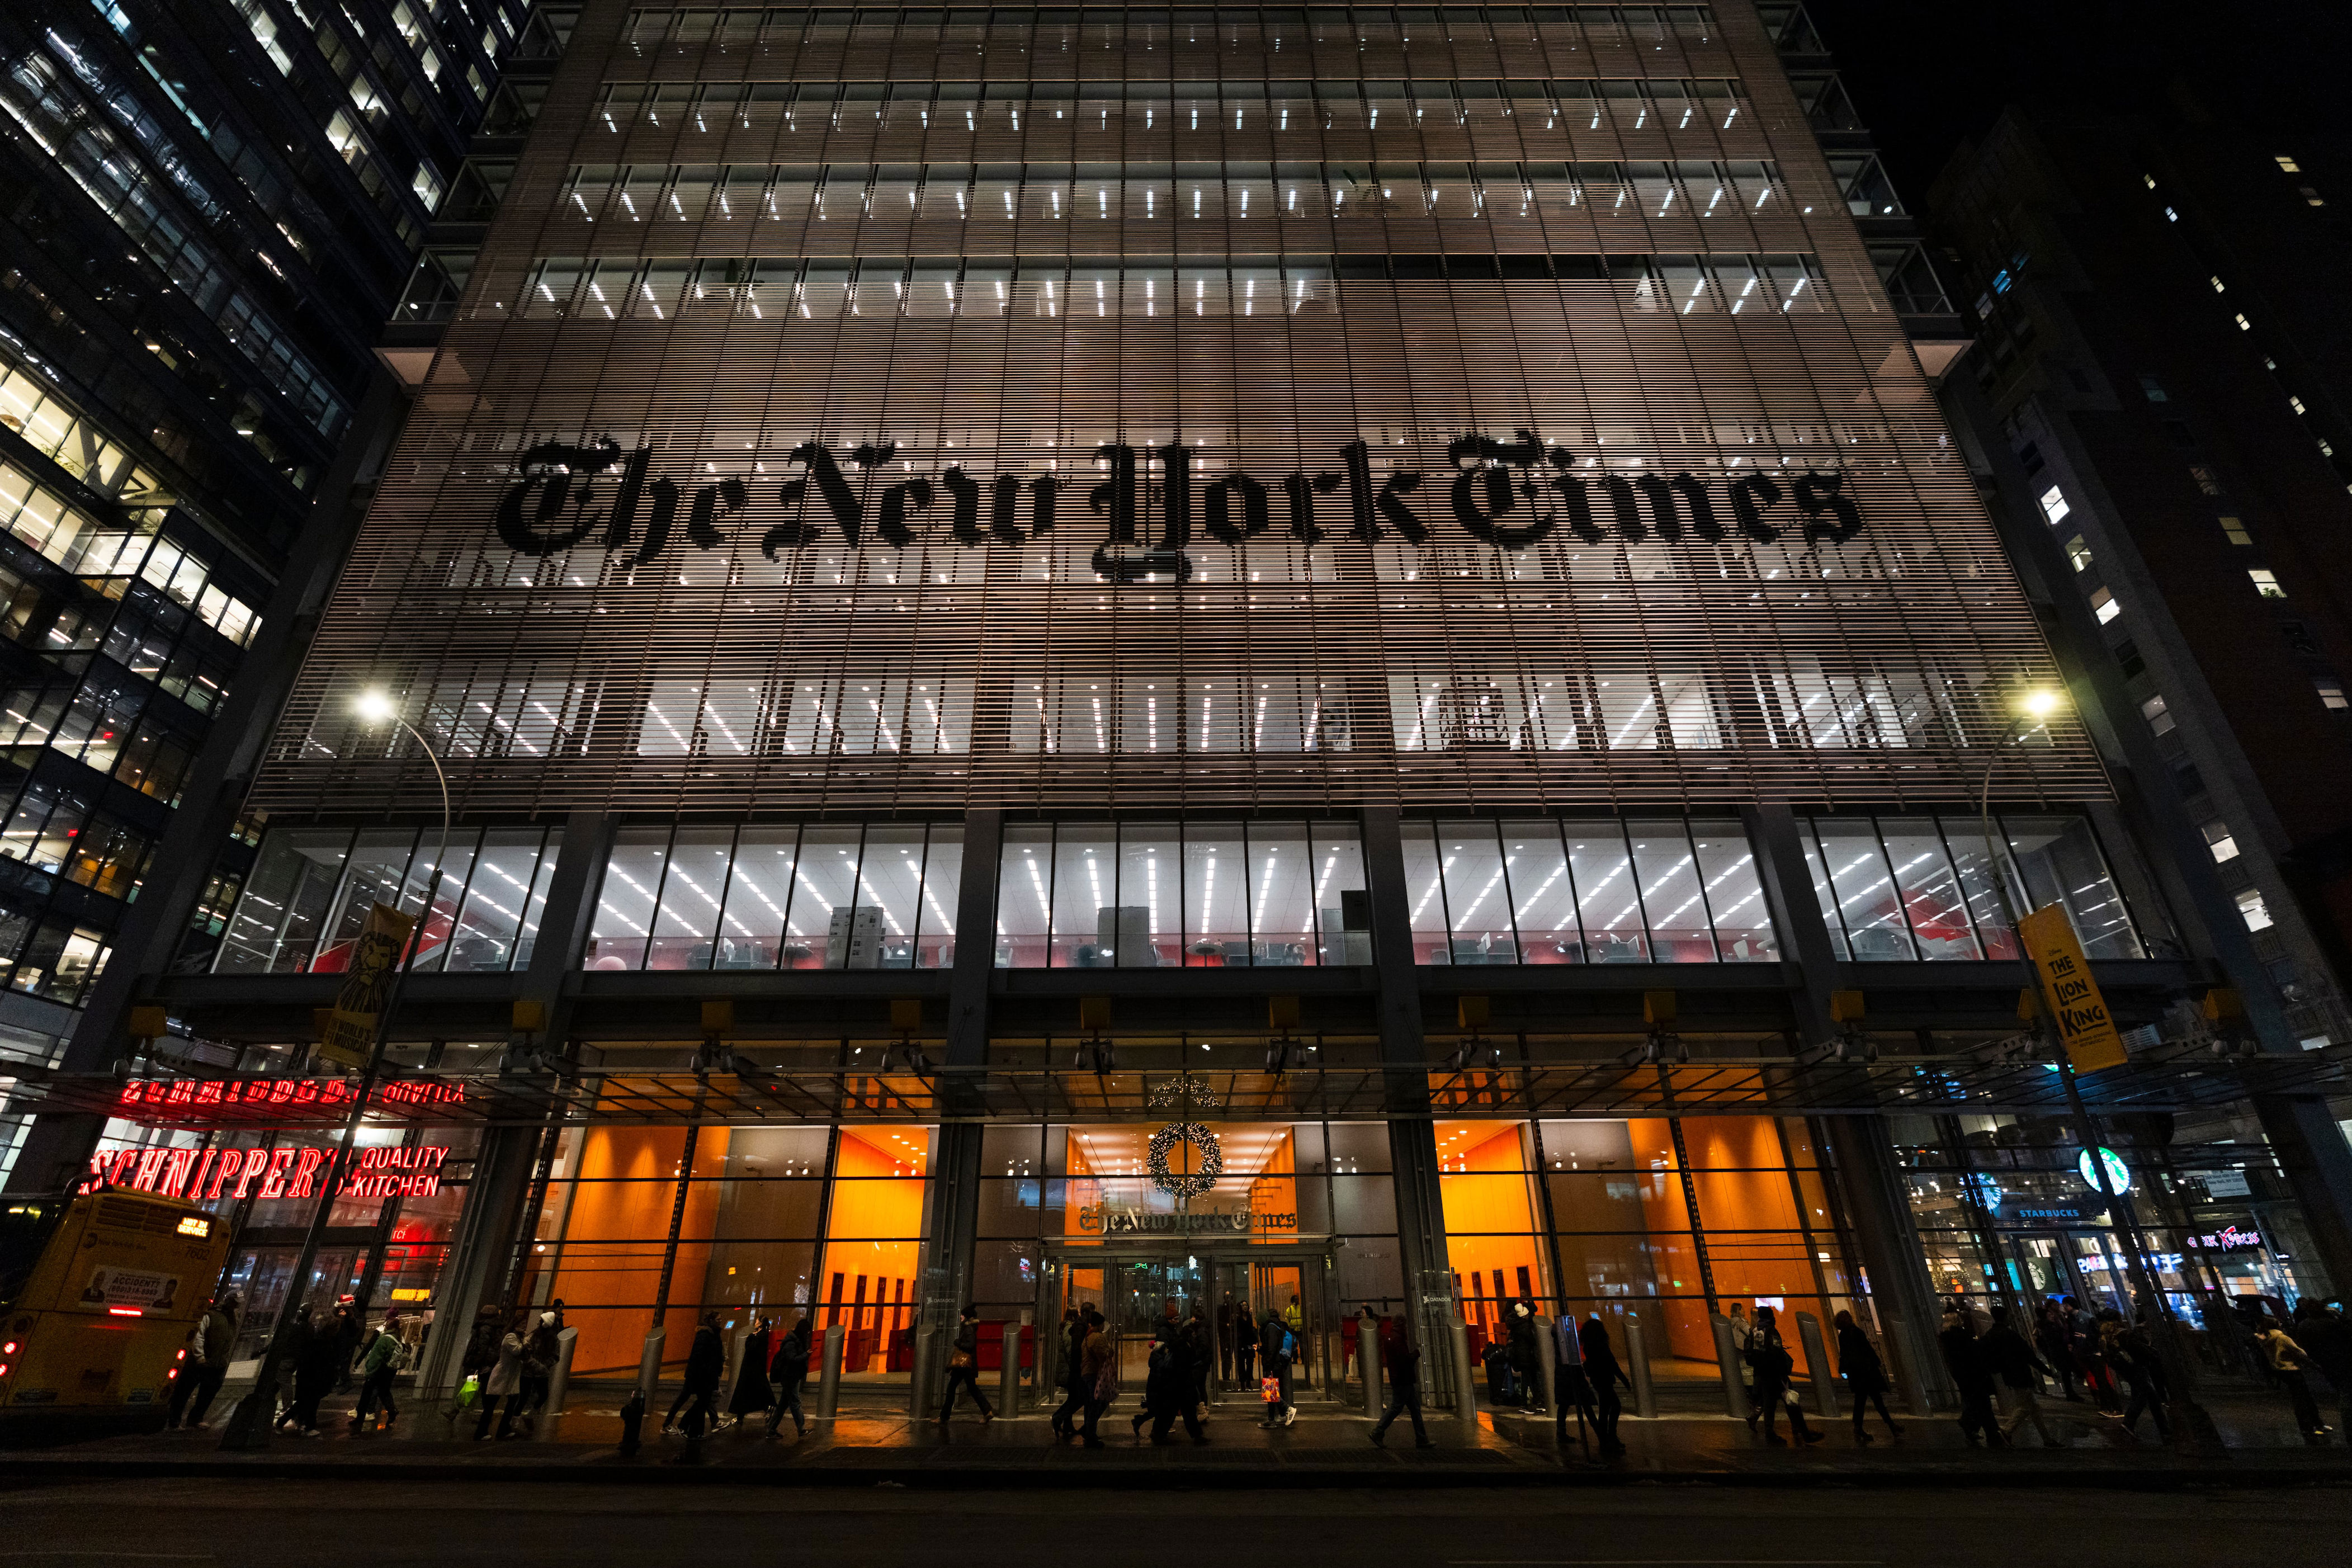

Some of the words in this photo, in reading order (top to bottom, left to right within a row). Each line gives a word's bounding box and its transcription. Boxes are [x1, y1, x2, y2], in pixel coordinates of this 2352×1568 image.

[497, 437, 747, 567] The
[762, 440, 1066, 563] New
[1090, 439, 1429, 582] York
[1449, 429, 1863, 550] Times
[2048, 956, 2074, 974] THE
[2053, 979, 2088, 1007] LION
[338, 1019, 371, 1041] WORLD'S
[2060, 1005, 2104, 1037] KING
[334, 1033, 366, 1054] MUSICAL
[361, 1147, 450, 1169] QUALITY
[351, 1175, 440, 1197] KITCHEN
[182, 1217, 199, 1227] NOT
[198, 1220, 209, 1229] IN
[1079, 1206, 1120, 1234] The
[1123, 1207, 1169, 1234] New
[1174, 1205, 1228, 1233] York
[1231, 1203, 1297, 1230] Times
[2019, 1209, 2080, 1217] STARBUCKS
[177, 1224, 209, 1238] SERVICE
